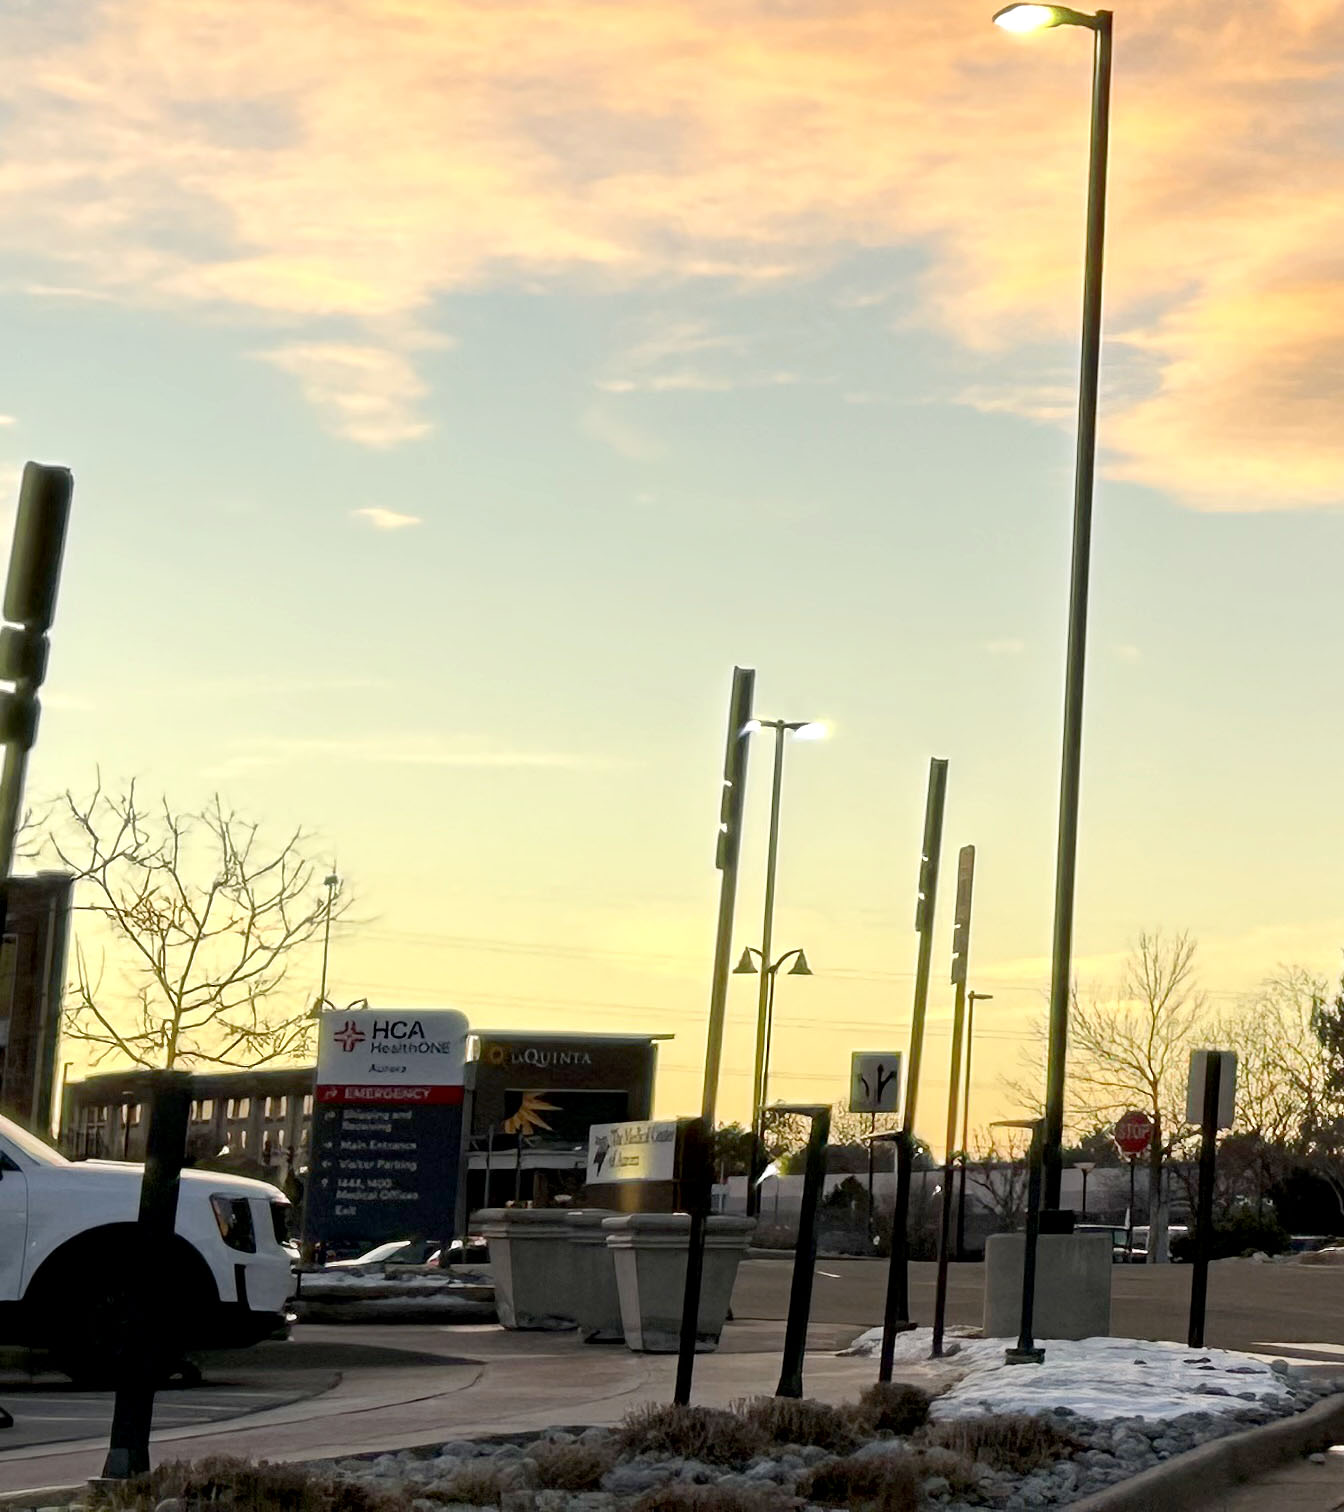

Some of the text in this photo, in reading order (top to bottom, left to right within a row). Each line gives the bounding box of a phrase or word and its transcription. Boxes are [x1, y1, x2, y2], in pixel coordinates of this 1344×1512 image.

[372, 1020, 425, 1039] HCA
[369, 1041, 450, 1055] HealthONE
[343, 1087, 431, 1100] EMERGENCY
[1119, 1122, 1151, 1140] STOP
